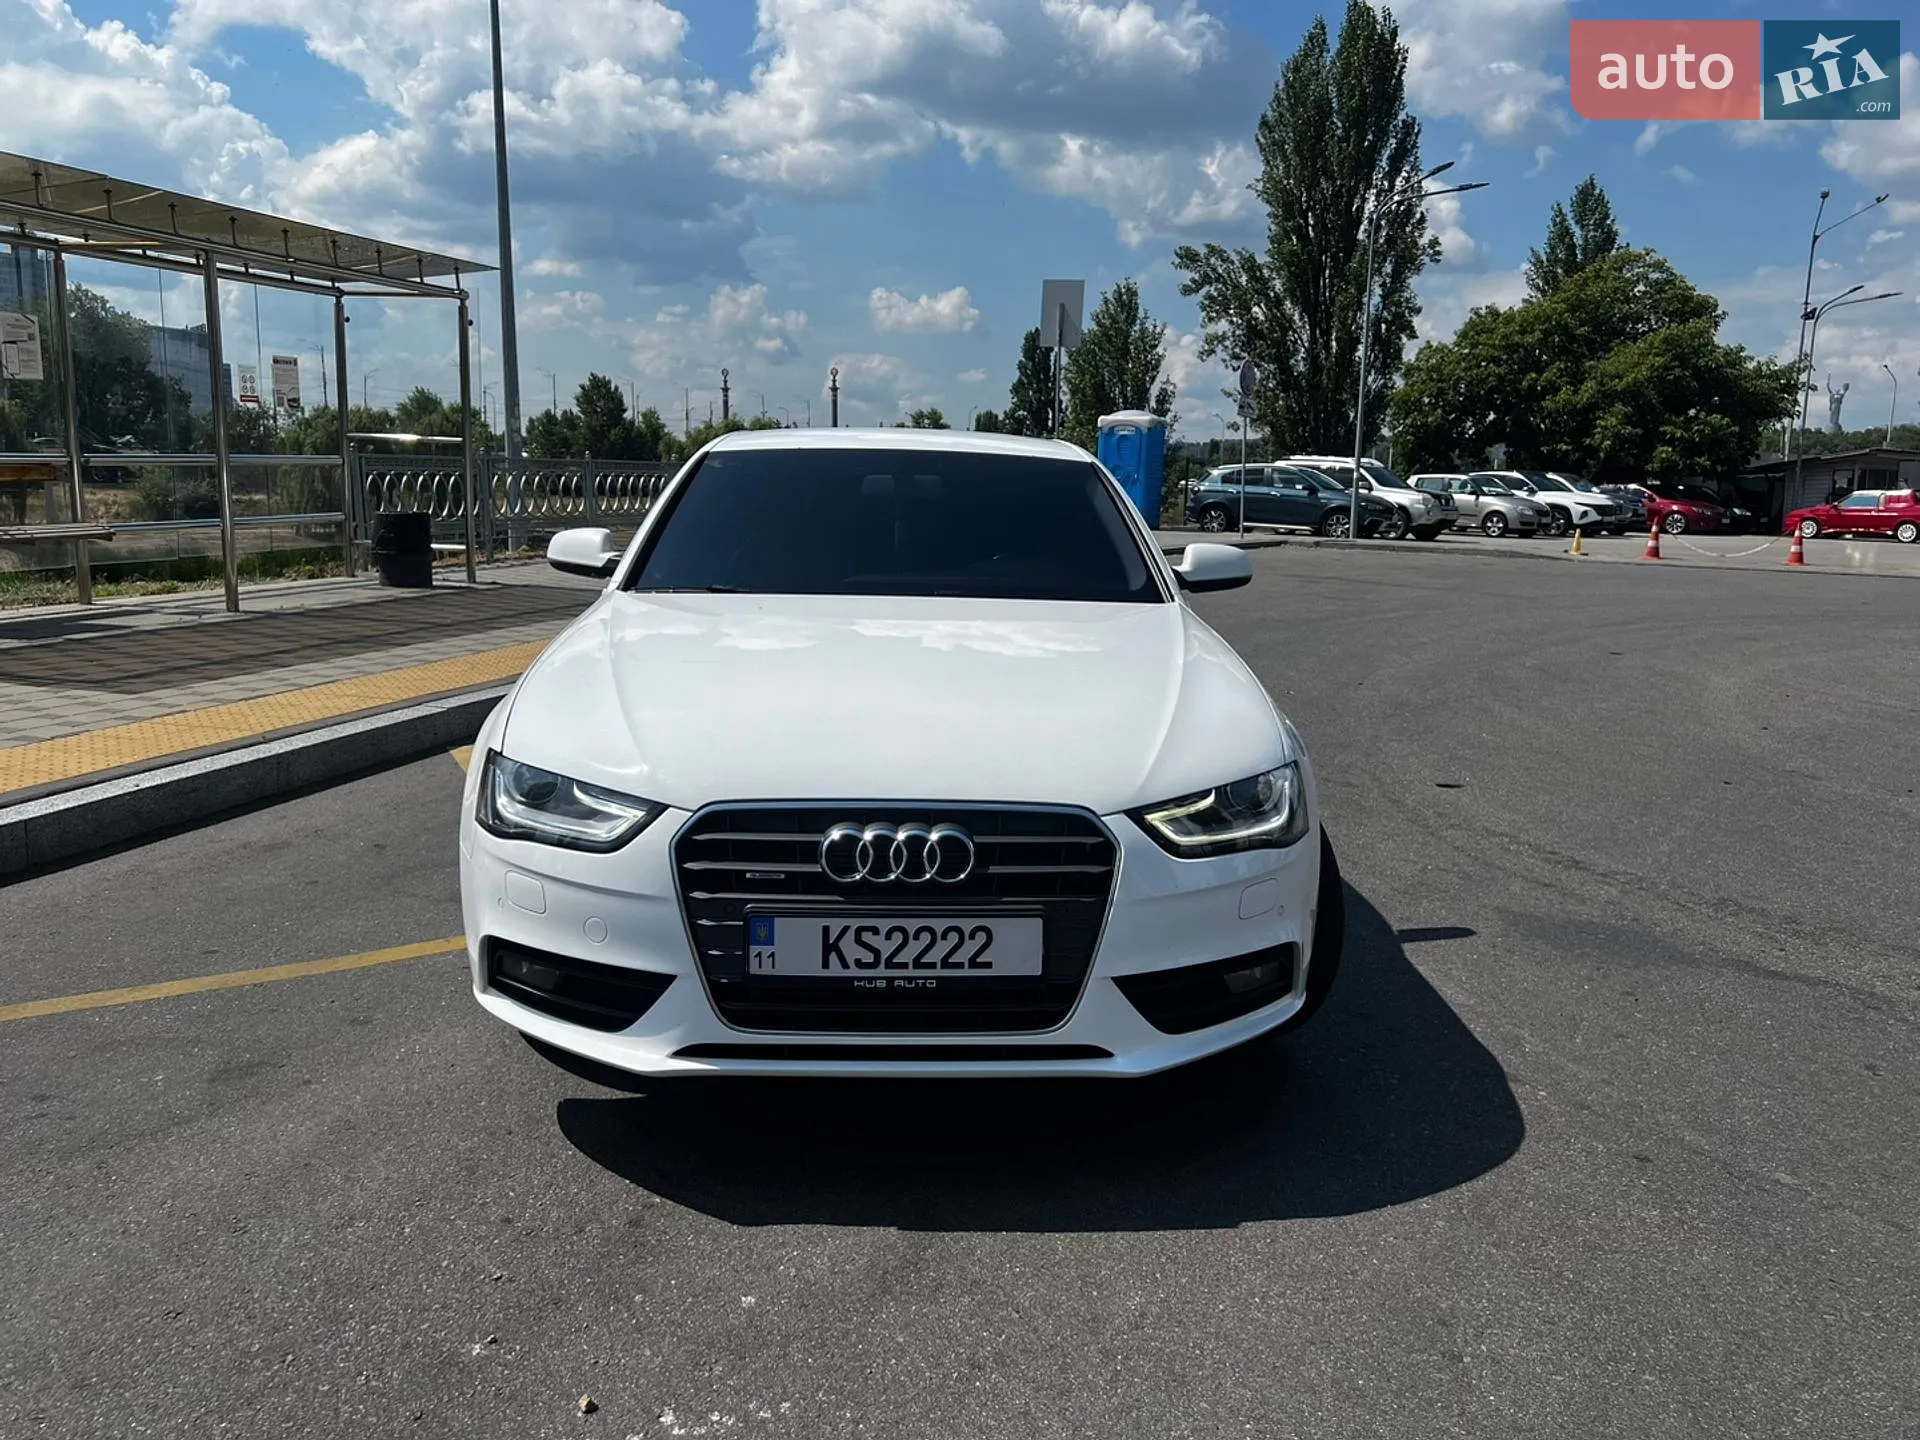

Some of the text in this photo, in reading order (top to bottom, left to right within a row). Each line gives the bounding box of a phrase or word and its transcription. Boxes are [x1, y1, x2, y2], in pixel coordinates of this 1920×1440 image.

[821, 924, 994, 970] KS2222
[753, 950, 776, 970] 11
[894, 979, 937, 988] AUTO
